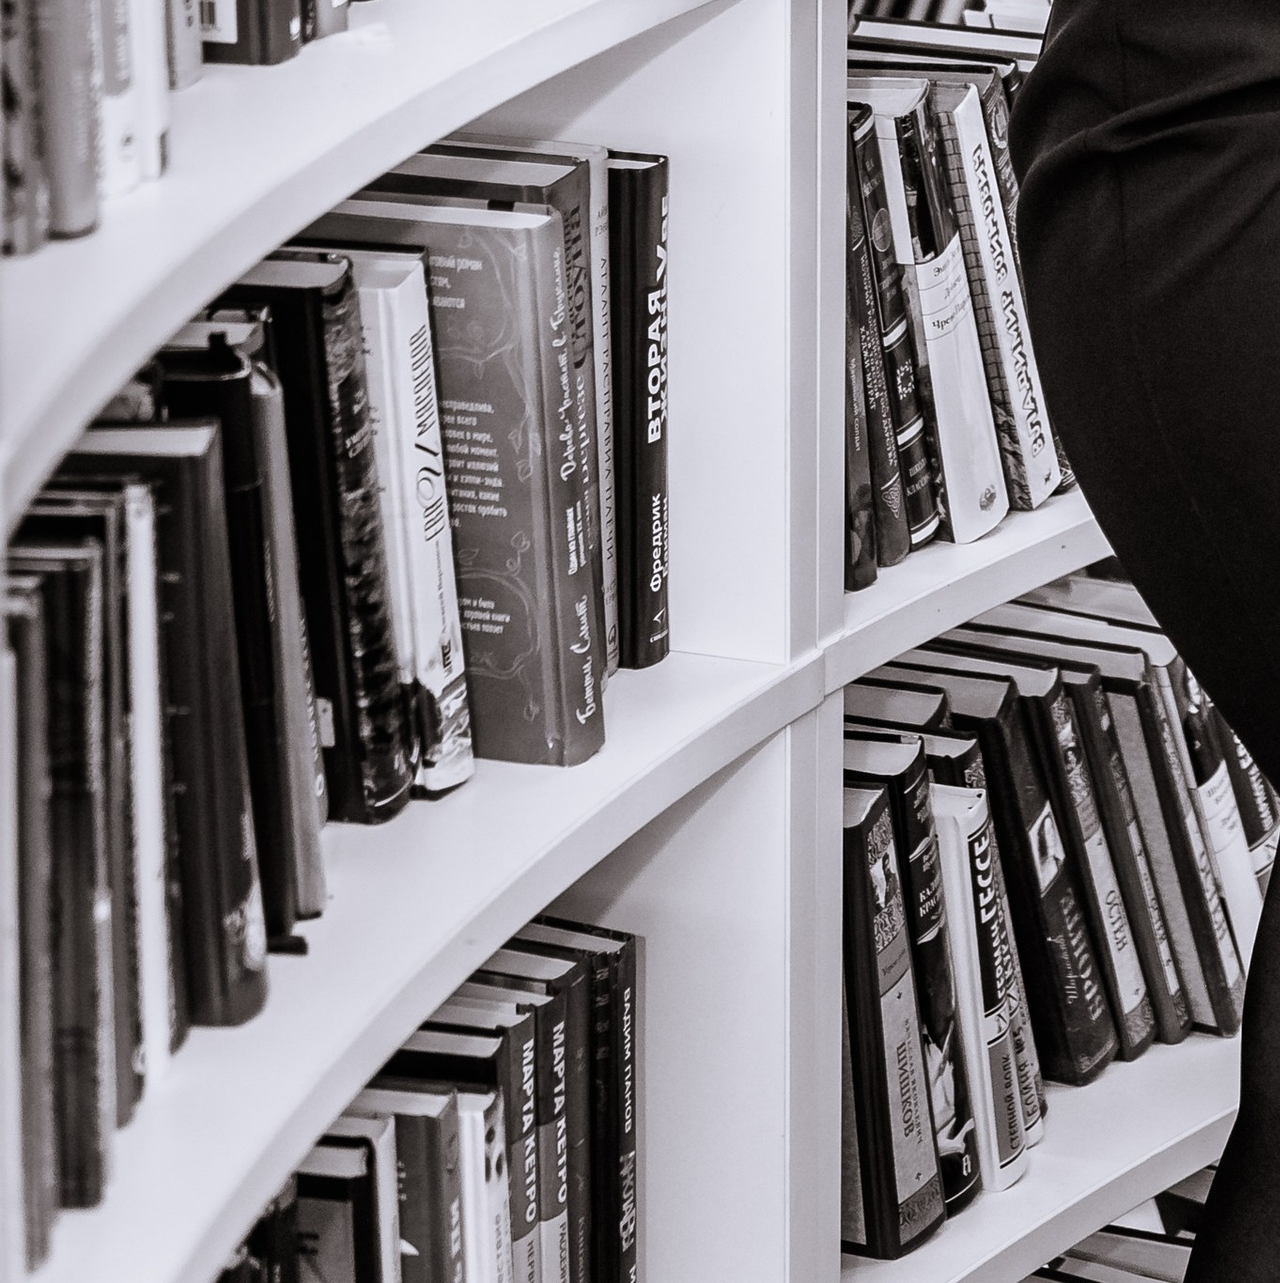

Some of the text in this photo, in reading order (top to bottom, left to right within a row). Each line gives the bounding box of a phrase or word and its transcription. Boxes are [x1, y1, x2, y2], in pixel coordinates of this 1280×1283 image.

[647, 289, 662, 444] ВТОРАЯ
[972, 144, 1045, 458] ВЛАДИМИР ВОЙНОВИЧ
[859, 326, 877, 410] ХАДЖИ-МУРАТ
[558, 419, 577, 482] Дерево
[650, 493, 663, 592] Фредрик
[569, 594, 596, 725] Бетти Смит
[974, 829, 1006, 999] ГЕРМАН ГЕССЕ
[553, 1020, 568, 1204] МАРТА КЕТРО
[623, 987, 633, 1134] ВАДИМ ПАНОВ
[896, 1042, 914, 1137] ШИШКОВ
[1002, 1054, 1020, 1149] СТЕПНОЙ ВОЛК
[1018, 1063, 1037, 1117] БОЙНЯ
[522, 1038, 537, 1224] МАРТА КЕТРО
